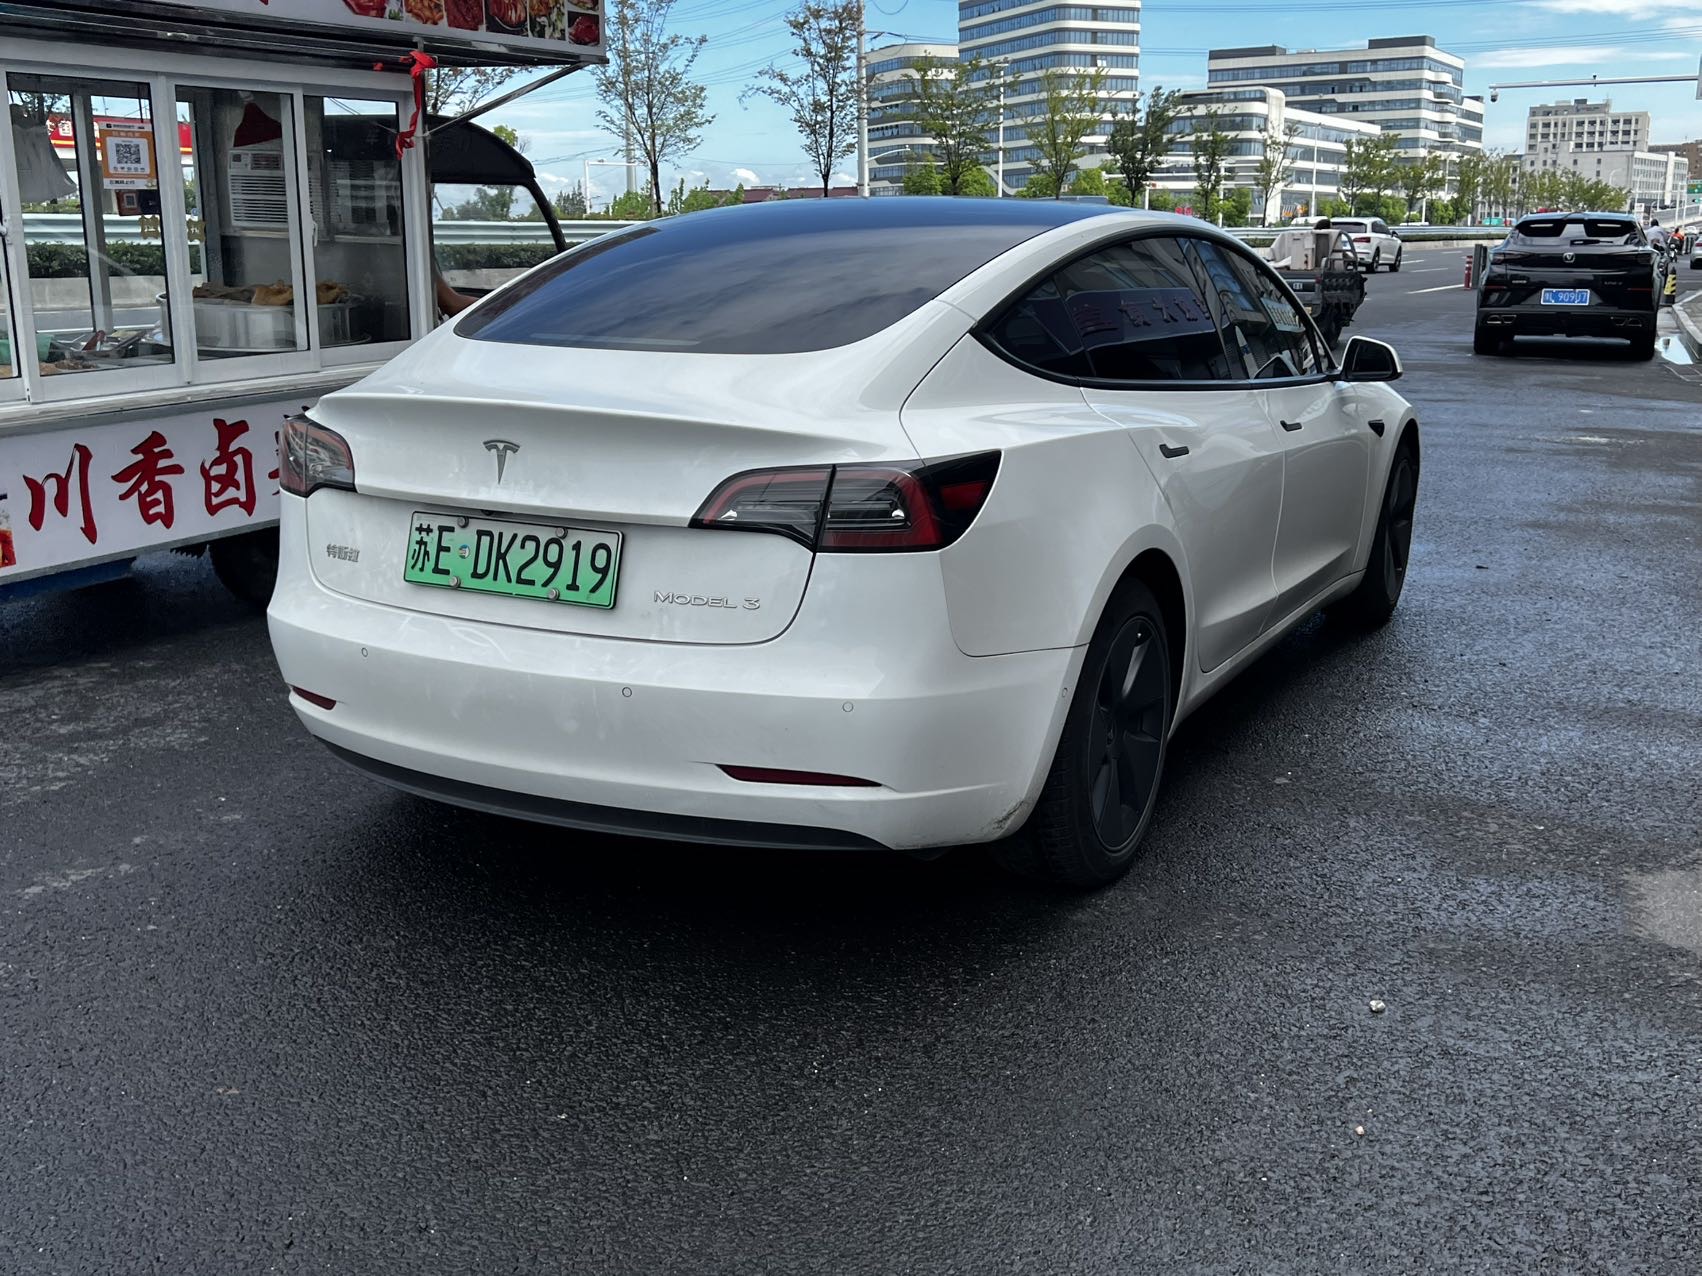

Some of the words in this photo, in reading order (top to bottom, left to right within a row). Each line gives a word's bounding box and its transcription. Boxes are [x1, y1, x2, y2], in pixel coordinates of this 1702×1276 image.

[23, 418, 280, 545] 川香卤
[654, 590, 738, 609] MODEL
[743, 597, 761, 610] 3
